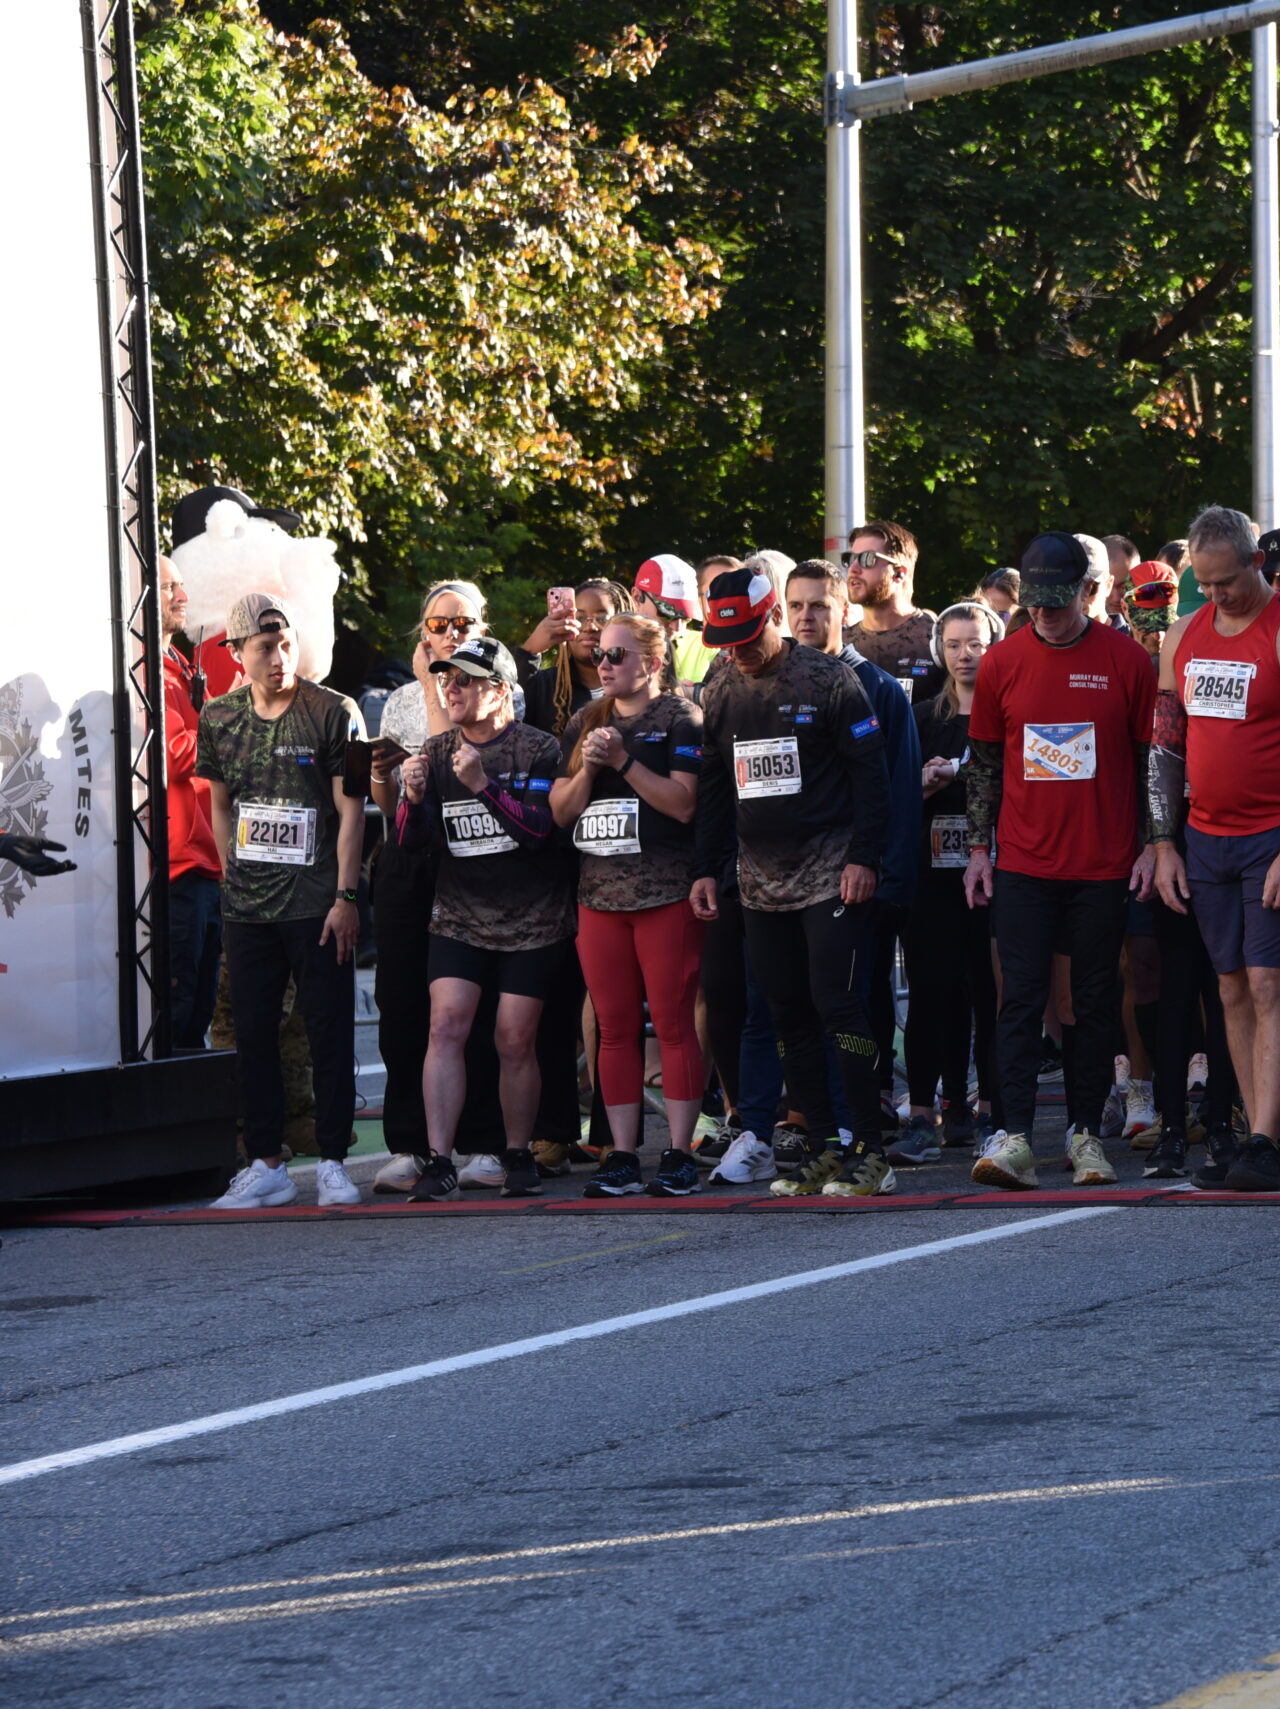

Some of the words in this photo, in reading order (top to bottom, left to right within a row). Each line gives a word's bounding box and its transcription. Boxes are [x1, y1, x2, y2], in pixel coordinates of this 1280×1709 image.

[1068, 681, 1098, 689] CONSULTING
[1069, 673, 1091, 681] MURRAY
[1194, 675, 1246, 700] 28545
[746, 753, 795, 779] 15053
[1027, 738, 1084, 774] 14805
[250, 820, 298, 845] 22121
[582, 814, 628, 839] 10997
